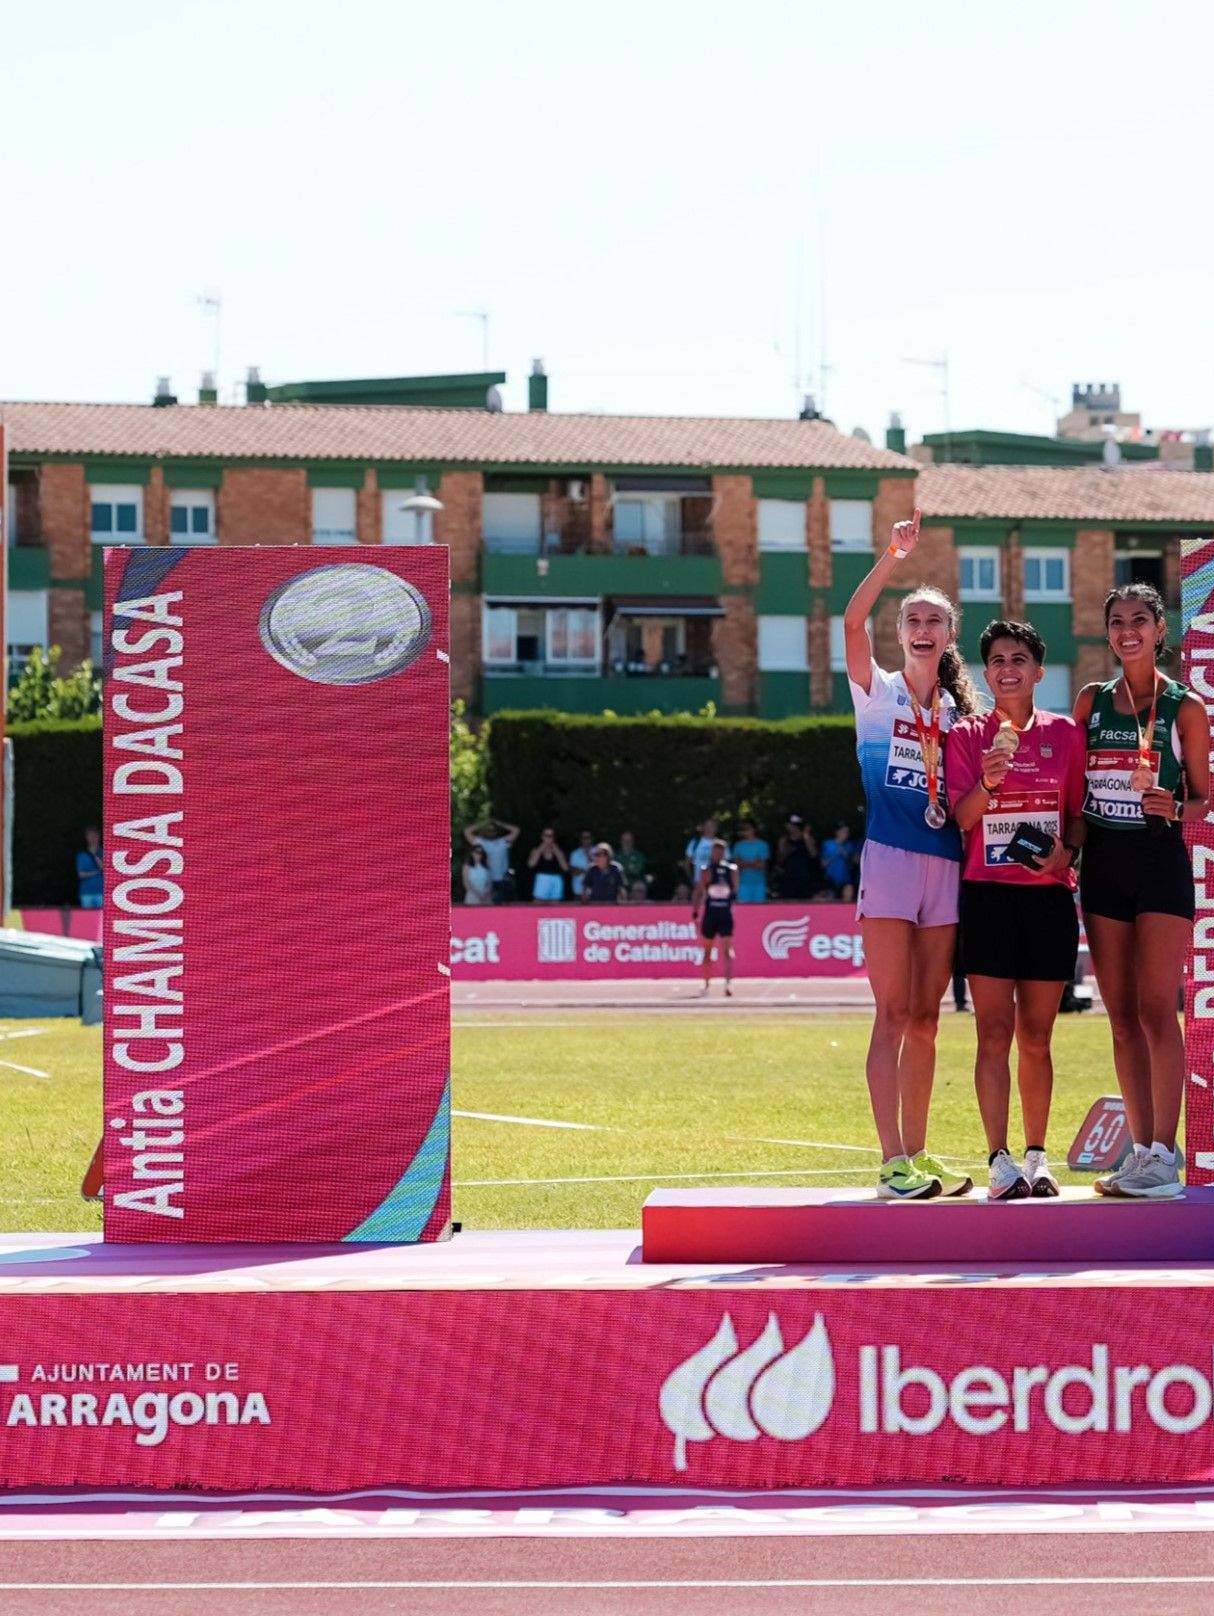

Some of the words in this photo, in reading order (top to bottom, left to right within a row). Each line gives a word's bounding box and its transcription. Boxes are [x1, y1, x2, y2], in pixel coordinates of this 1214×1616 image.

[111, 590, 184, 795] DACASA
[112, 810, 185, 1073] CHAMOSA
[584, 920, 698, 940] Generalitat
[584, 943, 609, 963] de
[1083, 1113, 1126, 1154] 60
[110, 1090, 184, 1219] Antia
[31, 1363, 194, 1383] AJUNTAMENT
[204, 1362, 240, 1381] DE
